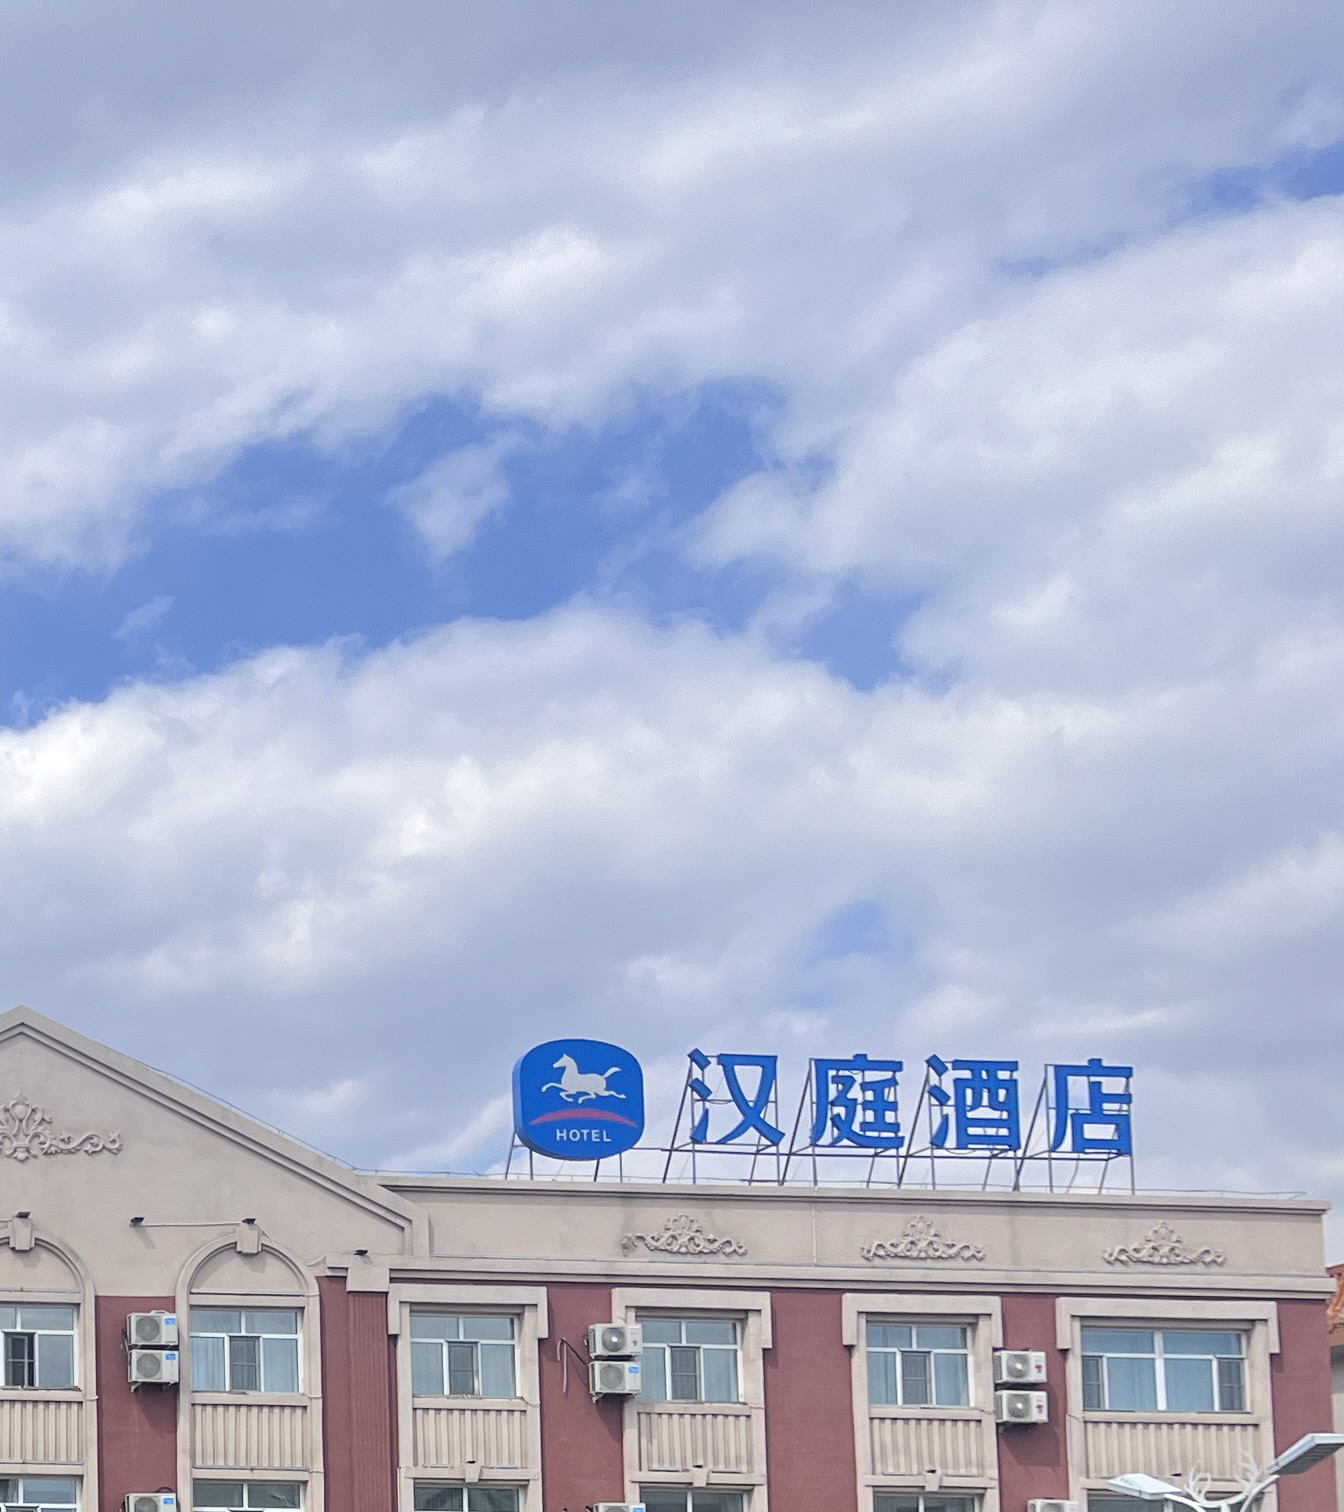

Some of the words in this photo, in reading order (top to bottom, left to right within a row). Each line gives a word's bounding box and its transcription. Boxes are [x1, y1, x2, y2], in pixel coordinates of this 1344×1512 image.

[687, 1047, 1133, 1156] 汉庭酒店
[555, 1128, 612, 1143] HOTEL
